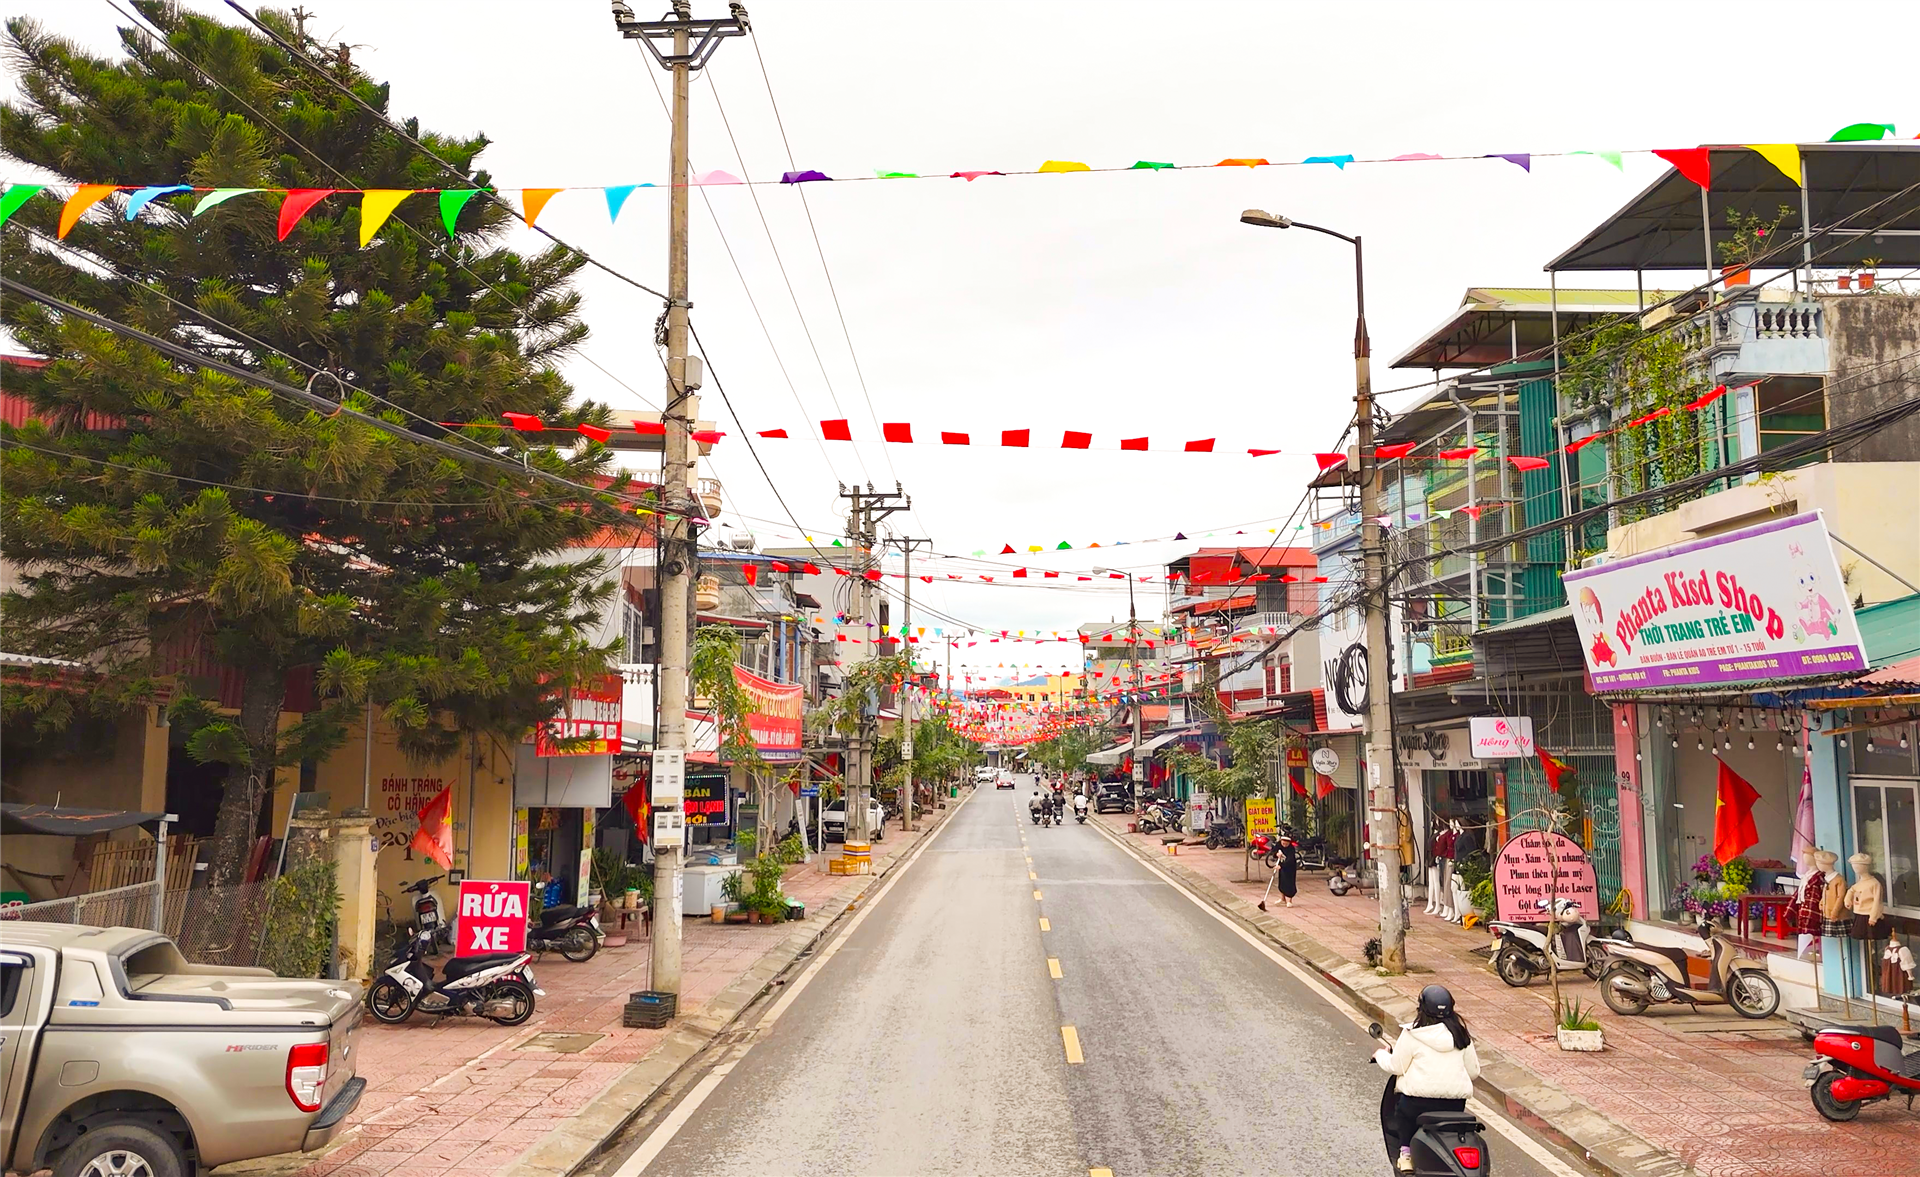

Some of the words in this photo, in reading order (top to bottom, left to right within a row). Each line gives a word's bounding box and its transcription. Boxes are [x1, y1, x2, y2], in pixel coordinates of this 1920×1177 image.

[1616, 586, 1667, 655] Phanta
[1664, 569, 1714, 608] Kisd
[1716, 569, 1784, 641] Shop
[1665, 620, 1705, 642] TRANG
[1704, 610, 1727, 638] TRẺ
[1731, 612, 1755, 634] EM
[1718, 646, 1727, 655] EM
[1744, 643, 1751, 653] 15
[382, 773, 407, 792] BÁNH
[412, 774, 442, 792] TRÁNG
[388, 793, 400, 811] CÔ
[1556, 838, 1565, 847] da
[1510, 869, 1529, 879] Phun
[1572, 883, 1593, 893] Laser
[462, 884, 523, 917] RỬA
[470, 927, 509, 950] XE
